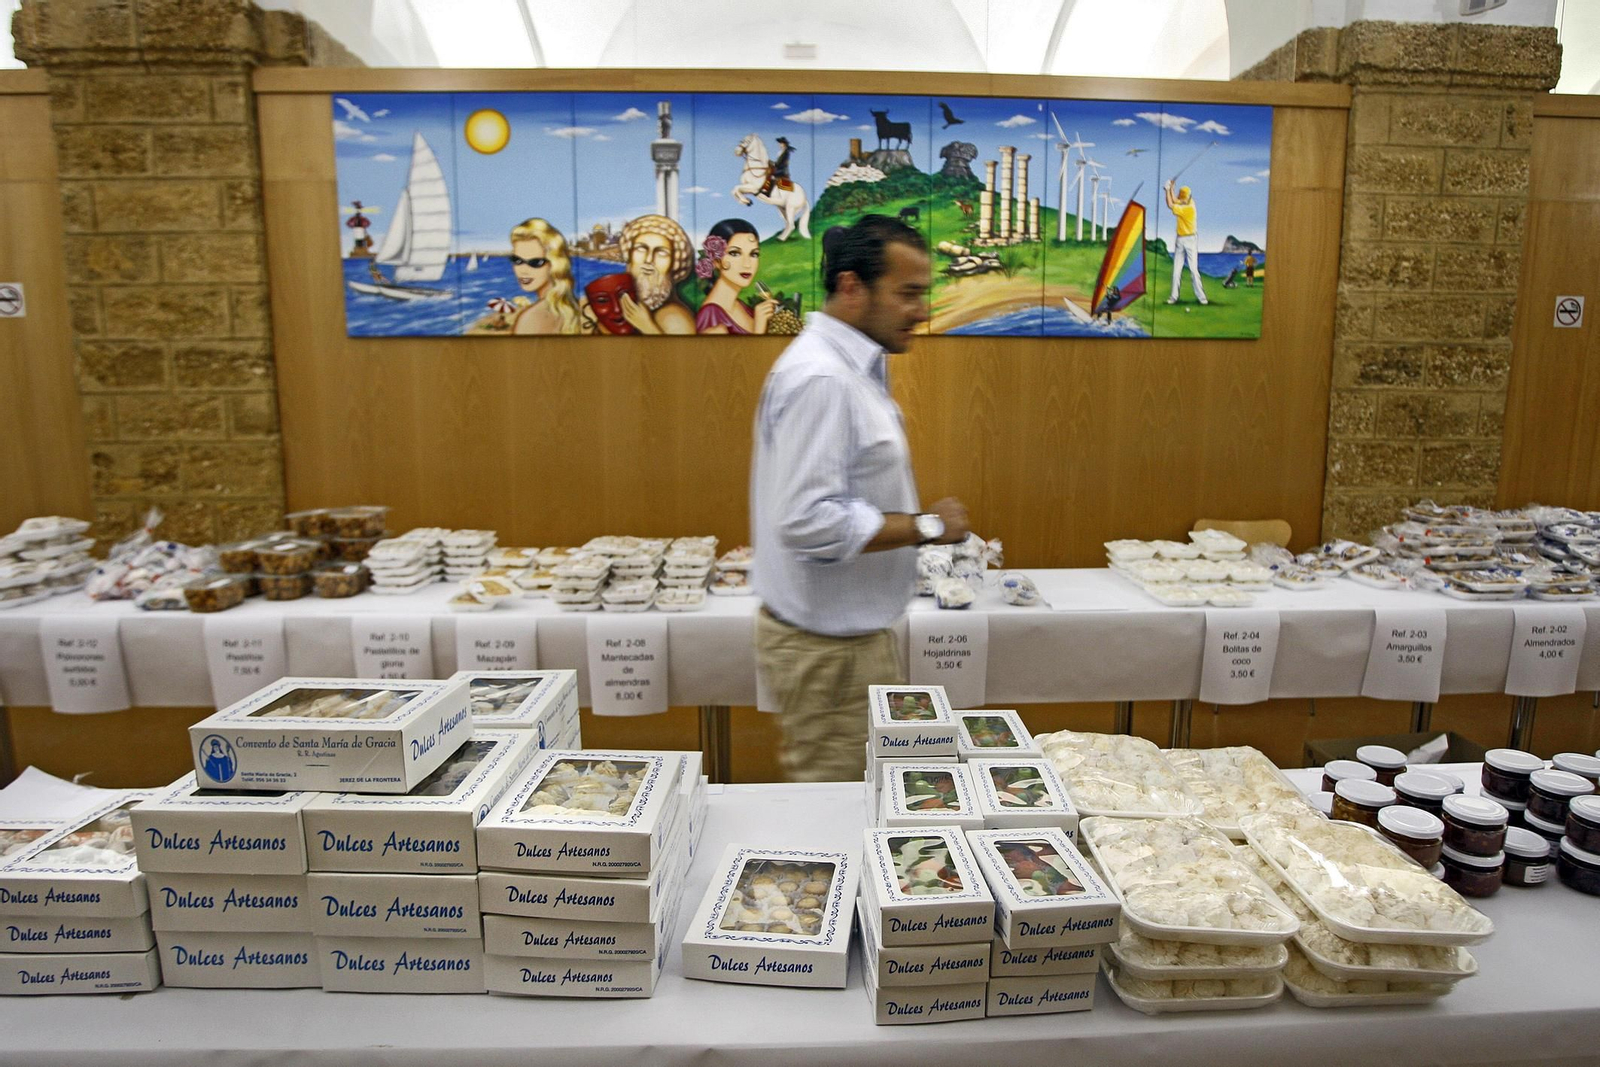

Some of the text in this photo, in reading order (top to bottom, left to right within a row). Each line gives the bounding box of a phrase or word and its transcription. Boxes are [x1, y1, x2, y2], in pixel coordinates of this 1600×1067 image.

[1242, 631, 1260, 640] 2-04
[1410, 630, 1428, 638] 2-03
[1550, 625, 1567, 634] 2-02
[625, 639, 647, 648] 2-08
[948, 634, 968, 644] 2-06
[1386, 642, 1433, 652] Amarguillos
[1524, 639, 1576, 647] Almendrados
[601, 653, 655, 662] Mantecadas
[923, 649, 972, 659] Hojaldrinas
[1222, 644, 1262, 653] Bolitas de
[1539, 650, 1557, 659] 4,00
[622, 666, 634, 674] de
[936, 660, 963, 670] 3,50 €
[1230, 669, 1248, 679] 3,50
[604, 678, 651, 687] almendras
[636, 691, 644, 700] €
[235, 735, 396, 749] Convento de Santa María de Gracia
[410, 706, 467, 761] Dulces Artesanos
[880, 734, 954, 749] Dulces Artesanos
[145, 828, 286, 855] Dulces Artesanos
[317, 830, 460, 856] Dulces Artesanos
[514, 842, 610, 860] Dulces Artesanos
[0, 887, 101, 907] Dulces Artesanos
[160, 887, 298, 913] Dulces Artesanos
[505, 886, 615, 908] Dulces Artesanos
[321, 896, 463, 922] Dulces Artesanos
[888, 917, 928, 933] Dulces
[932, 913, 988, 933] Artesanos
[1017, 922, 1056, 937] Dulces
[1060, 917, 1114, 937] Artesanos
[5, 924, 112, 943] Dulces Artesanos
[522, 931, 616, 949] Dulces Artesanos
[170, 946, 308, 970] Dulces Artesanos
[331, 950, 470, 976] Dulces Artesanos
[708, 954, 814, 975] Dulces Artesanos
[886, 956, 984, 975] Dulces Artesanos
[1000, 947, 1095, 966] Dulces Artesanos
[17, 967, 111, 985] Dulces Artesanos
[520, 968, 613, 986] Dulces Artesanos
[997, 988, 1090, 1007] Dulces Artesanos
[886, 998, 982, 1016] Dulces Artesanos
